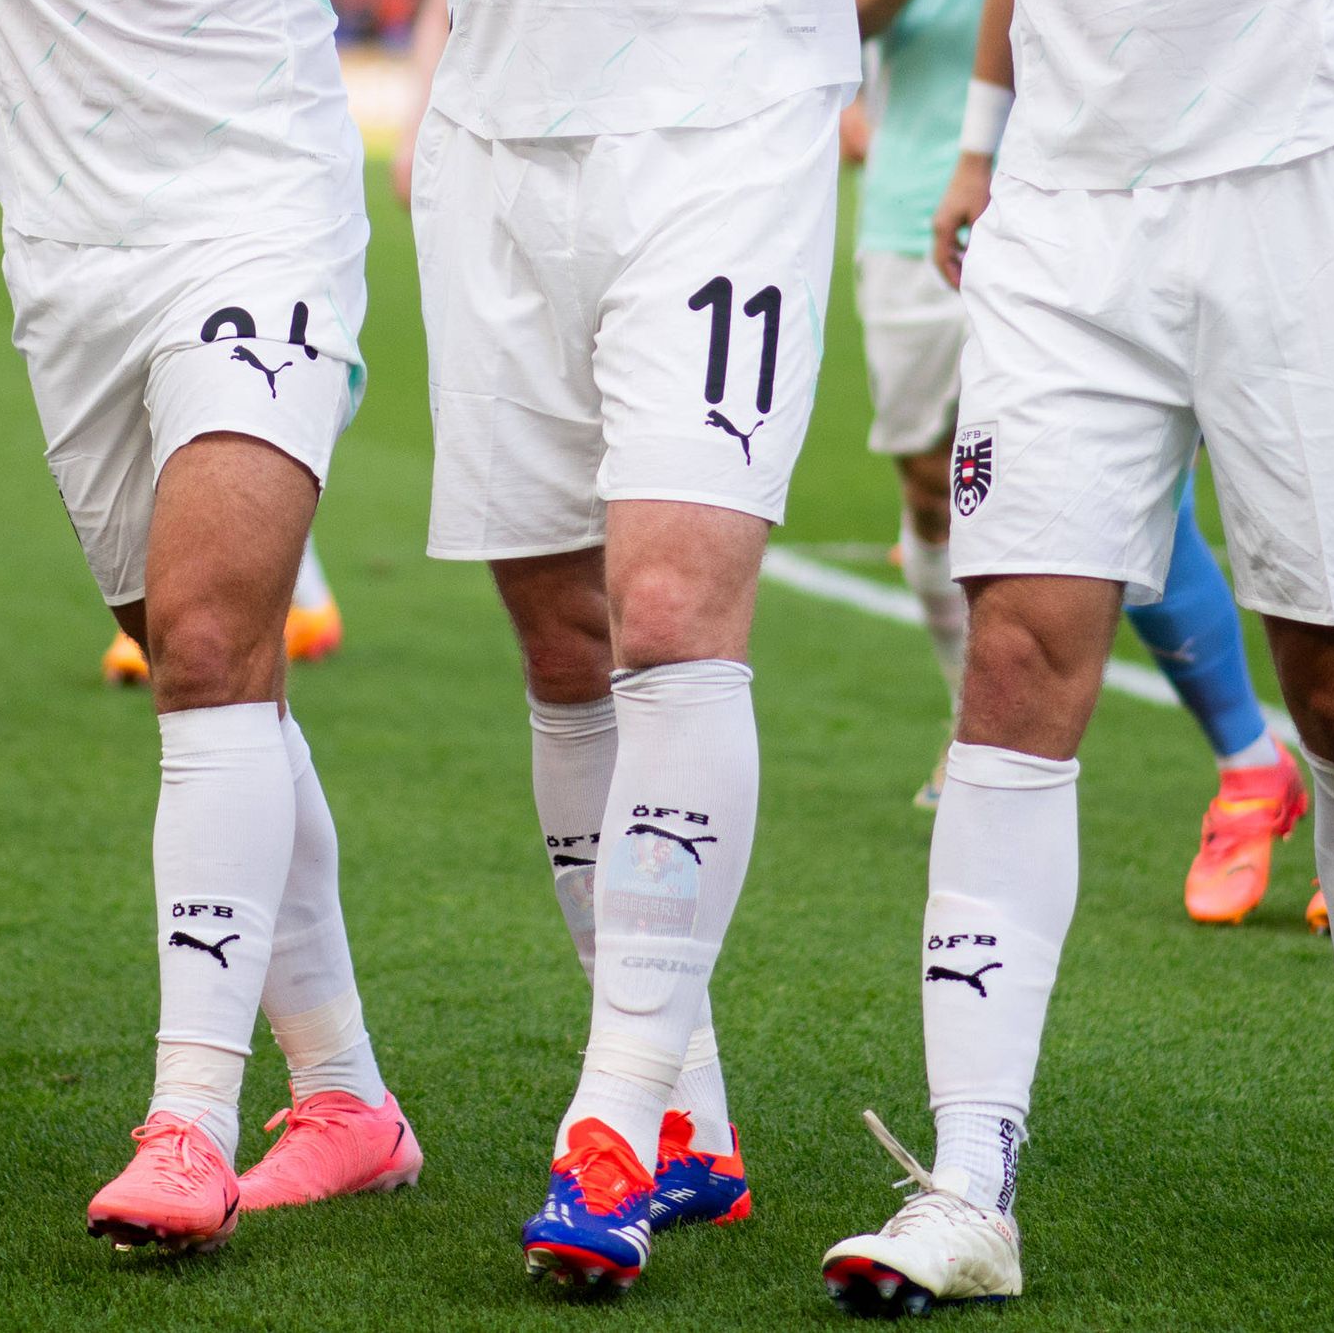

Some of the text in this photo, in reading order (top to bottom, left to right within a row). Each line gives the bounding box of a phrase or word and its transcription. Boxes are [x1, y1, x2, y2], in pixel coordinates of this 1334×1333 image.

[689, 277, 781, 414] 11
[632, 804, 709, 826] ÖFB
[172, 902, 234, 919] ÖFB
[928, 935, 997, 950] ÖFB
